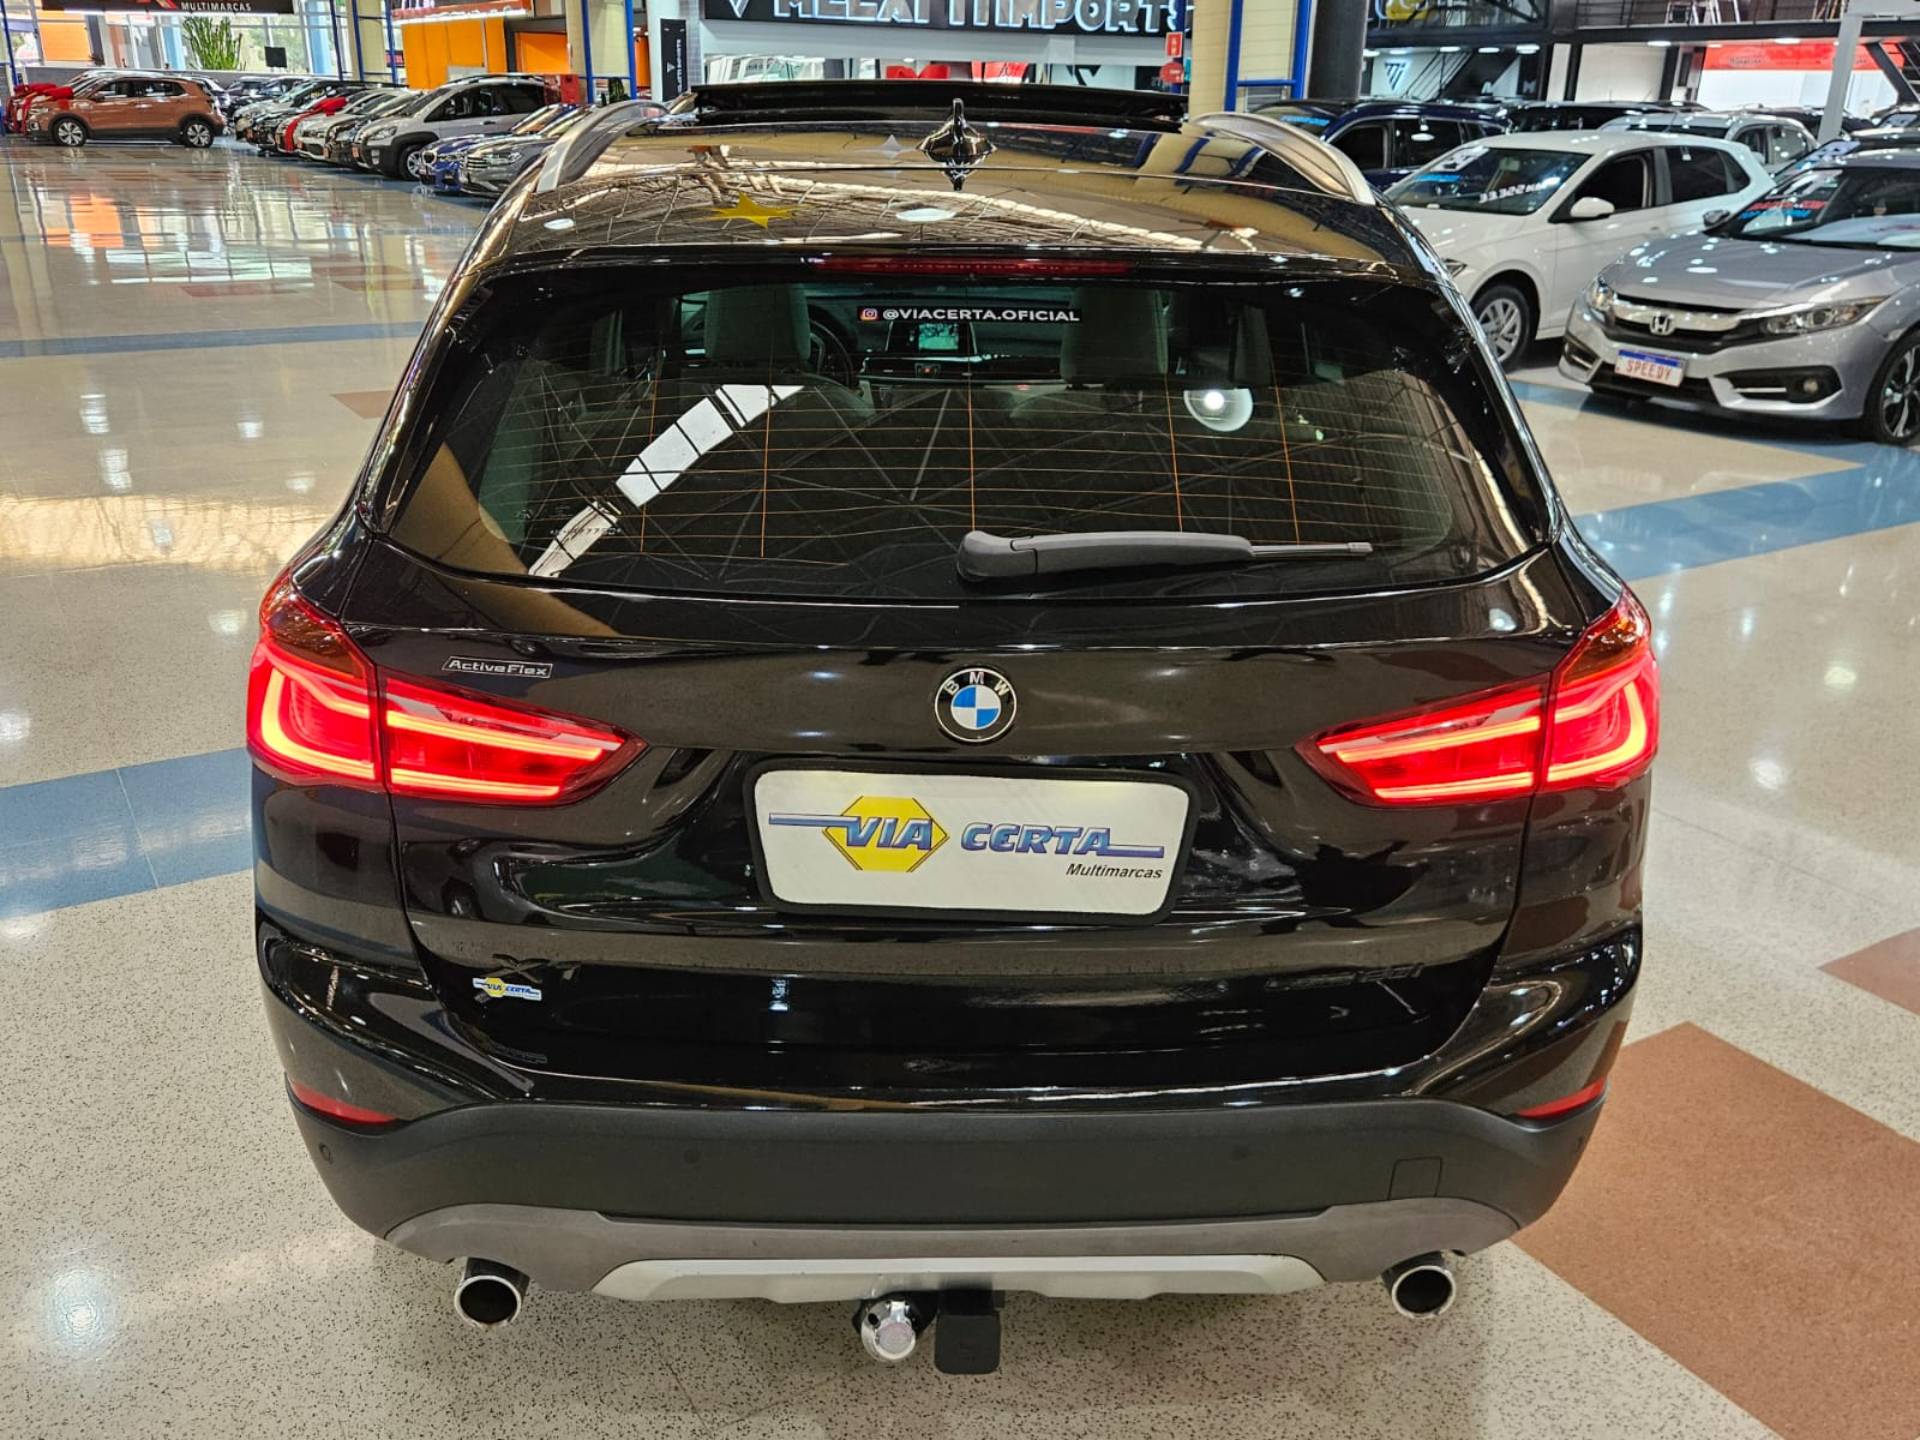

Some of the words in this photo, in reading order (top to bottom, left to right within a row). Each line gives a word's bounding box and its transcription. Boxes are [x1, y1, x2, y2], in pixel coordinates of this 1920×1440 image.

[180, 2, 252, 12] MULTIMARCAS
[882, 308, 1080, 322] @VIACERTA.OFICIAL
[1626, 359, 1672, 381] SPEEDY
[448, 659, 548, 676] ActiveFlex
[943, 671, 1010, 697] BMW
[846, 816, 933, 851] VIA
[961, 821, 1112, 857] CERTA
[1065, 862, 1164, 880] Multimarcas
